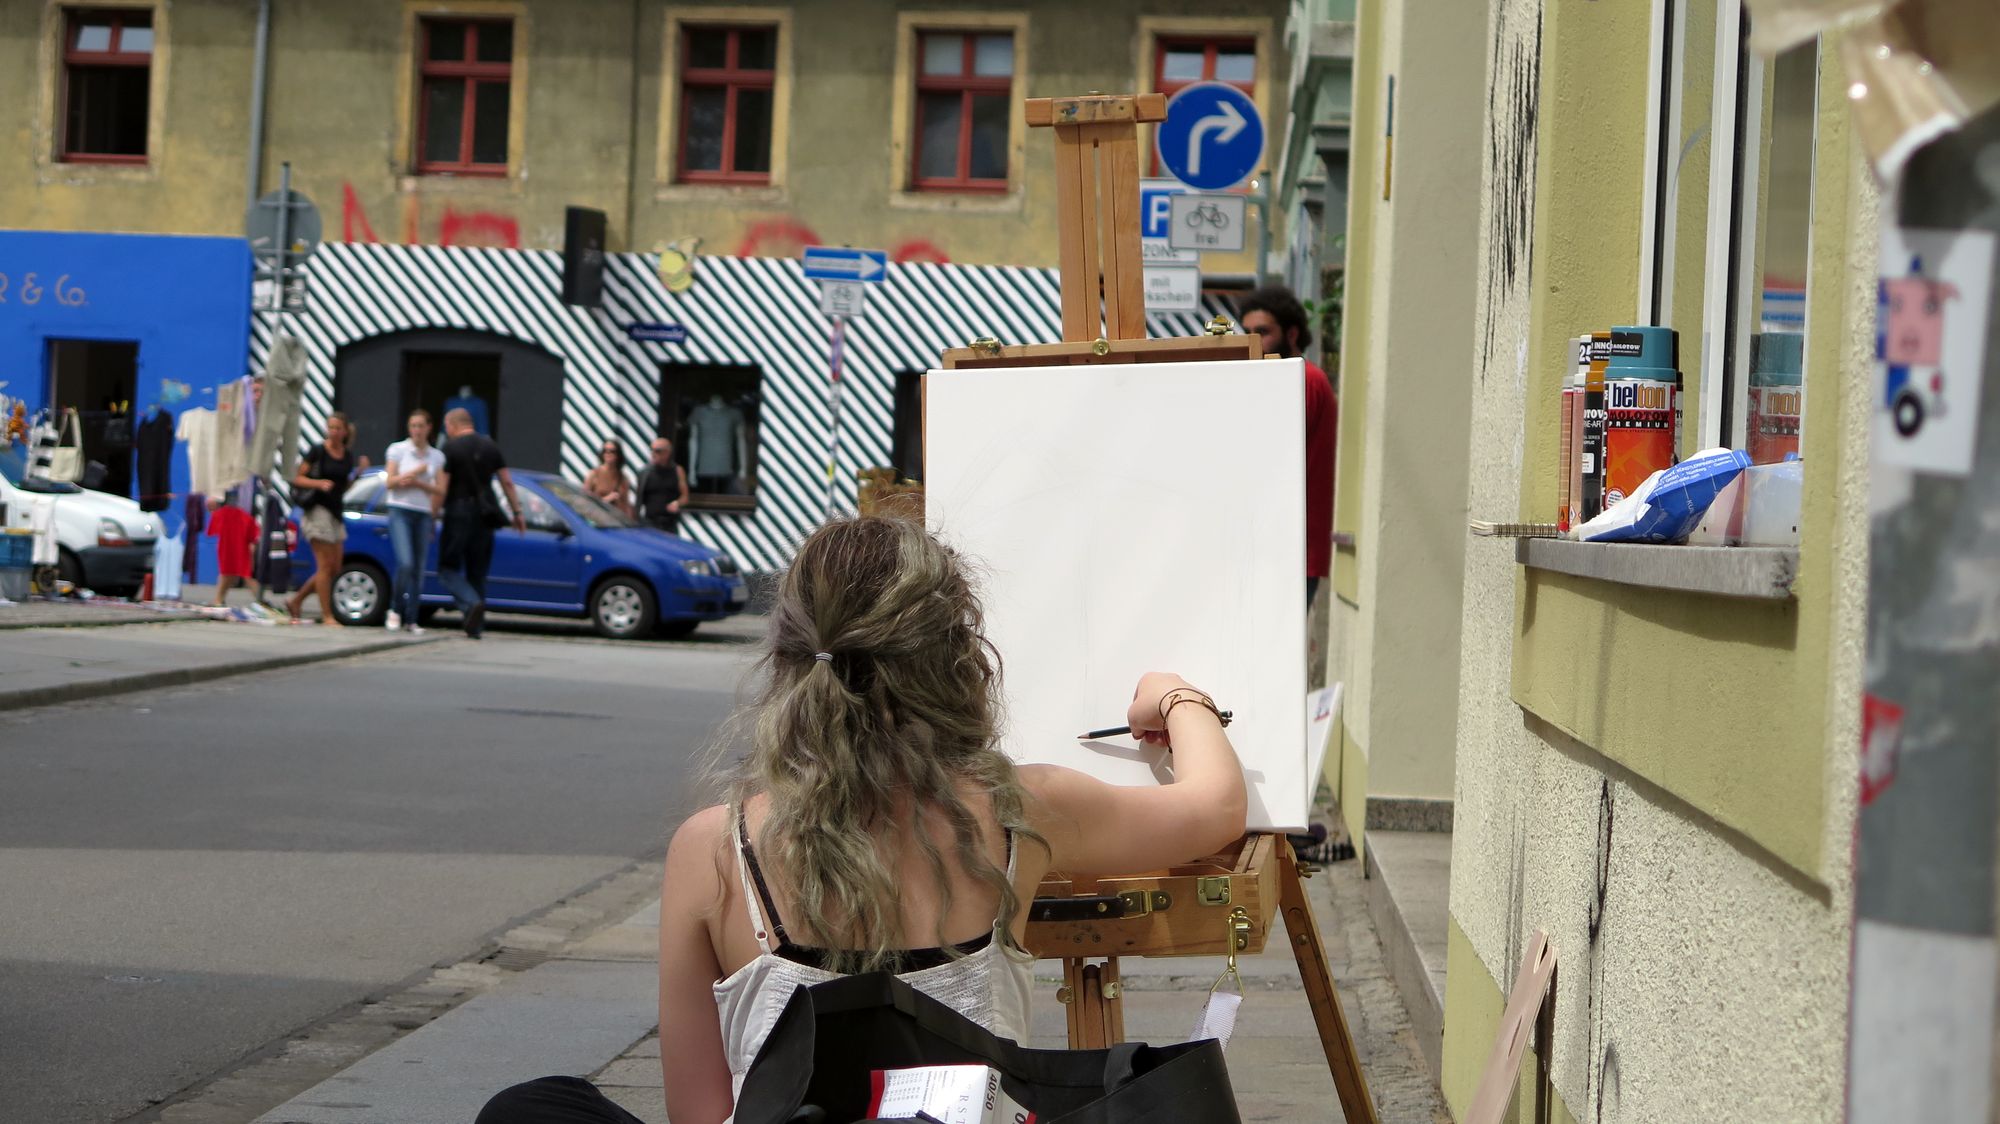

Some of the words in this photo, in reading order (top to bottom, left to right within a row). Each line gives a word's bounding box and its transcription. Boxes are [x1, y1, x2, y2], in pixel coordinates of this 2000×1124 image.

[1195, 233, 1219, 245] frei
[20, 271, 43, 304] &
[1151, 276, 1170, 288] mit
[1612, 382, 1666, 409] belton
[1609, 410, 1670, 420] MOLOTOW
[986, 1074, 998, 1111] 40/50
